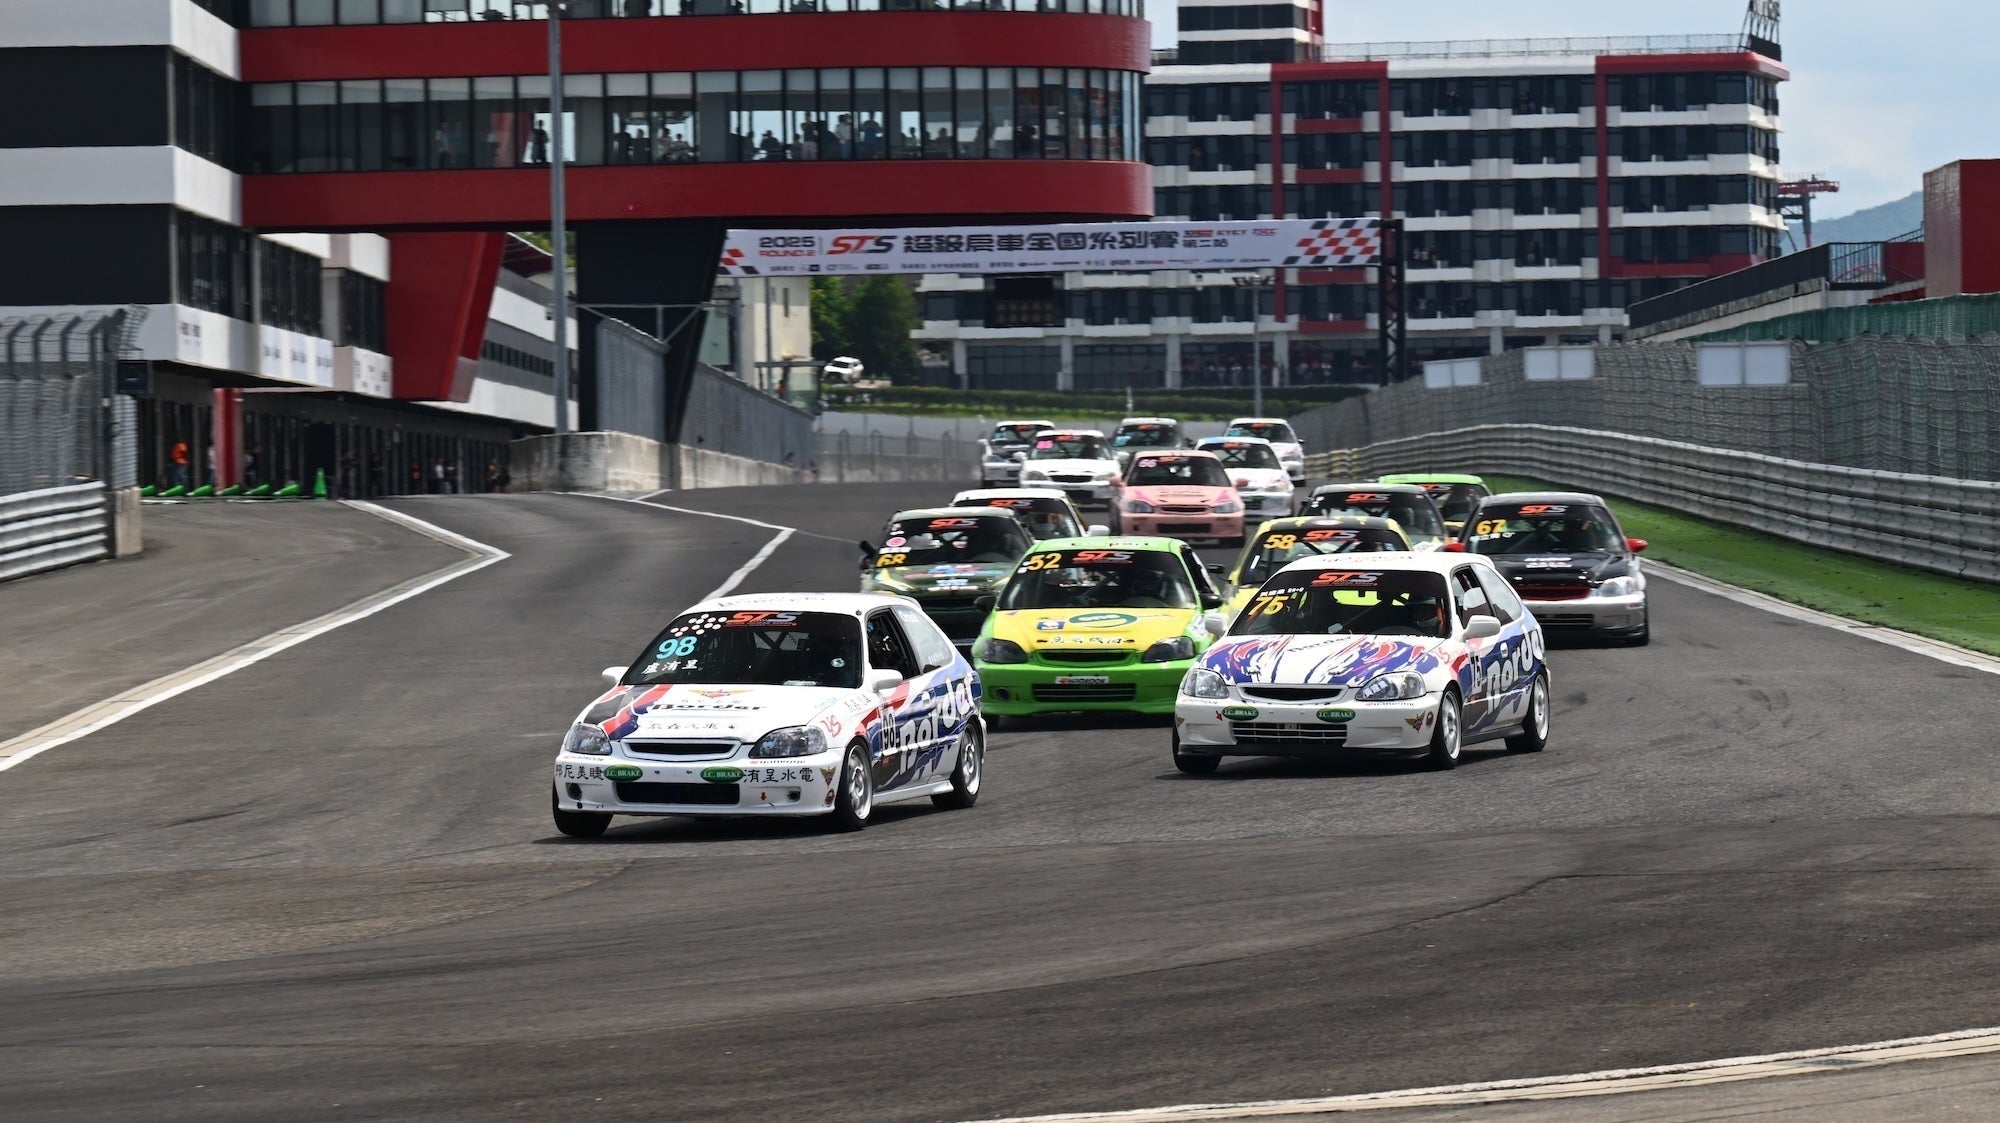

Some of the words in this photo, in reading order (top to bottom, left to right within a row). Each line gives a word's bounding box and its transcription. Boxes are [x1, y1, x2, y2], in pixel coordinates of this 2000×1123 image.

[759, 236, 815, 248] 2025
[827, 235, 898, 255] STS
[759, 249, 806, 257] ROUND
[807, 249, 816, 257] 2
[1345, 493, 1392, 503] STS
[1518, 504, 1569, 515] STS
[928, 518, 979, 528] STS
[1476, 519, 1508, 535] 67
[1302, 530, 1360, 541] STS
[1263, 534, 1297, 550] 58
[876, 553, 907, 567] 68
[1029, 552, 1063, 570] 52
[1072, 550, 1135, 562] STS
[1311, 572, 1384, 584] STS
[1248, 595, 1290, 616] 75
[726, 611, 804, 624] STS
[656, 635, 698, 660] 98
[1470, 655, 1481, 688] 75
[652, 703, 767, 711] Border
[1223, 709, 1234, 717] J.C.
[1235, 709, 1257, 717] BRAKE
[882, 713, 896, 750] 98
[617, 769, 641, 777] BRAKE
[715, 770, 741, 778] BRAKE
[743, 767, 815, 783] 洧呈水電
